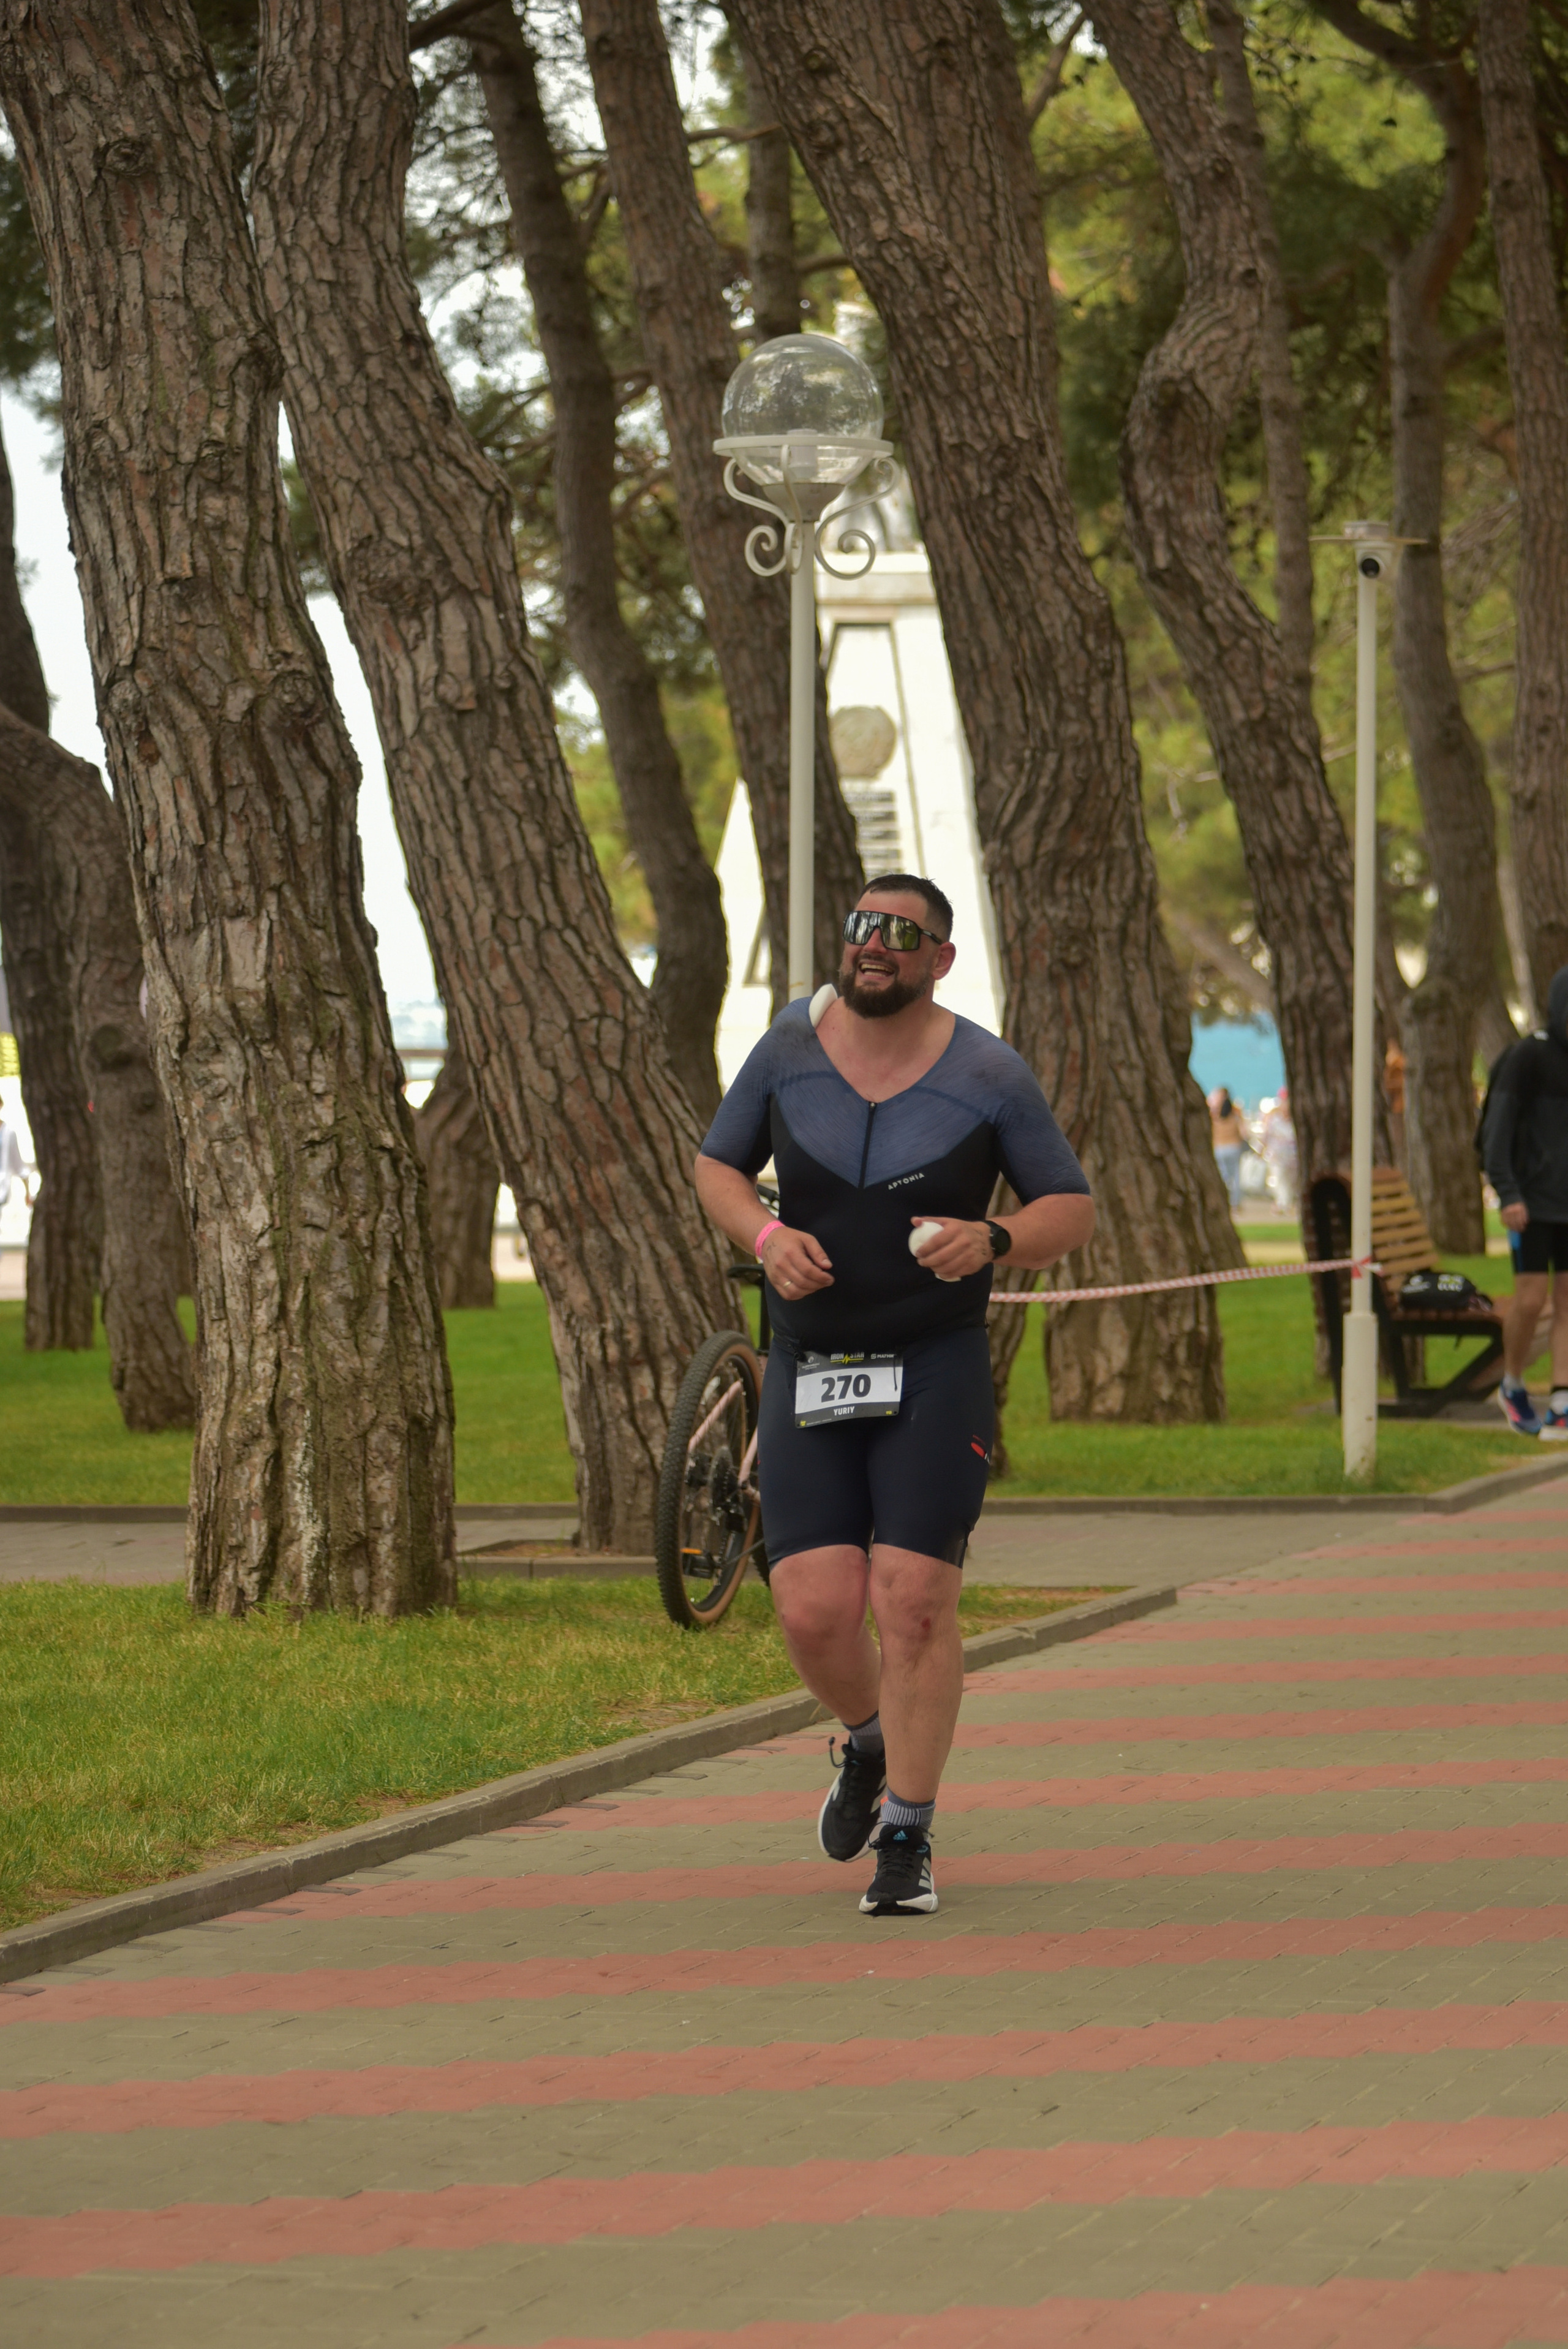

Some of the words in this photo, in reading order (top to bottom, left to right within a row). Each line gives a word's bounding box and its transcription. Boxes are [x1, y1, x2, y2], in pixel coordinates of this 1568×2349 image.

[888, 1173, 925, 1190] APTONIA
[821, 1374, 871, 1403] 270
[833, 1406, 855, 1416] YURIY
